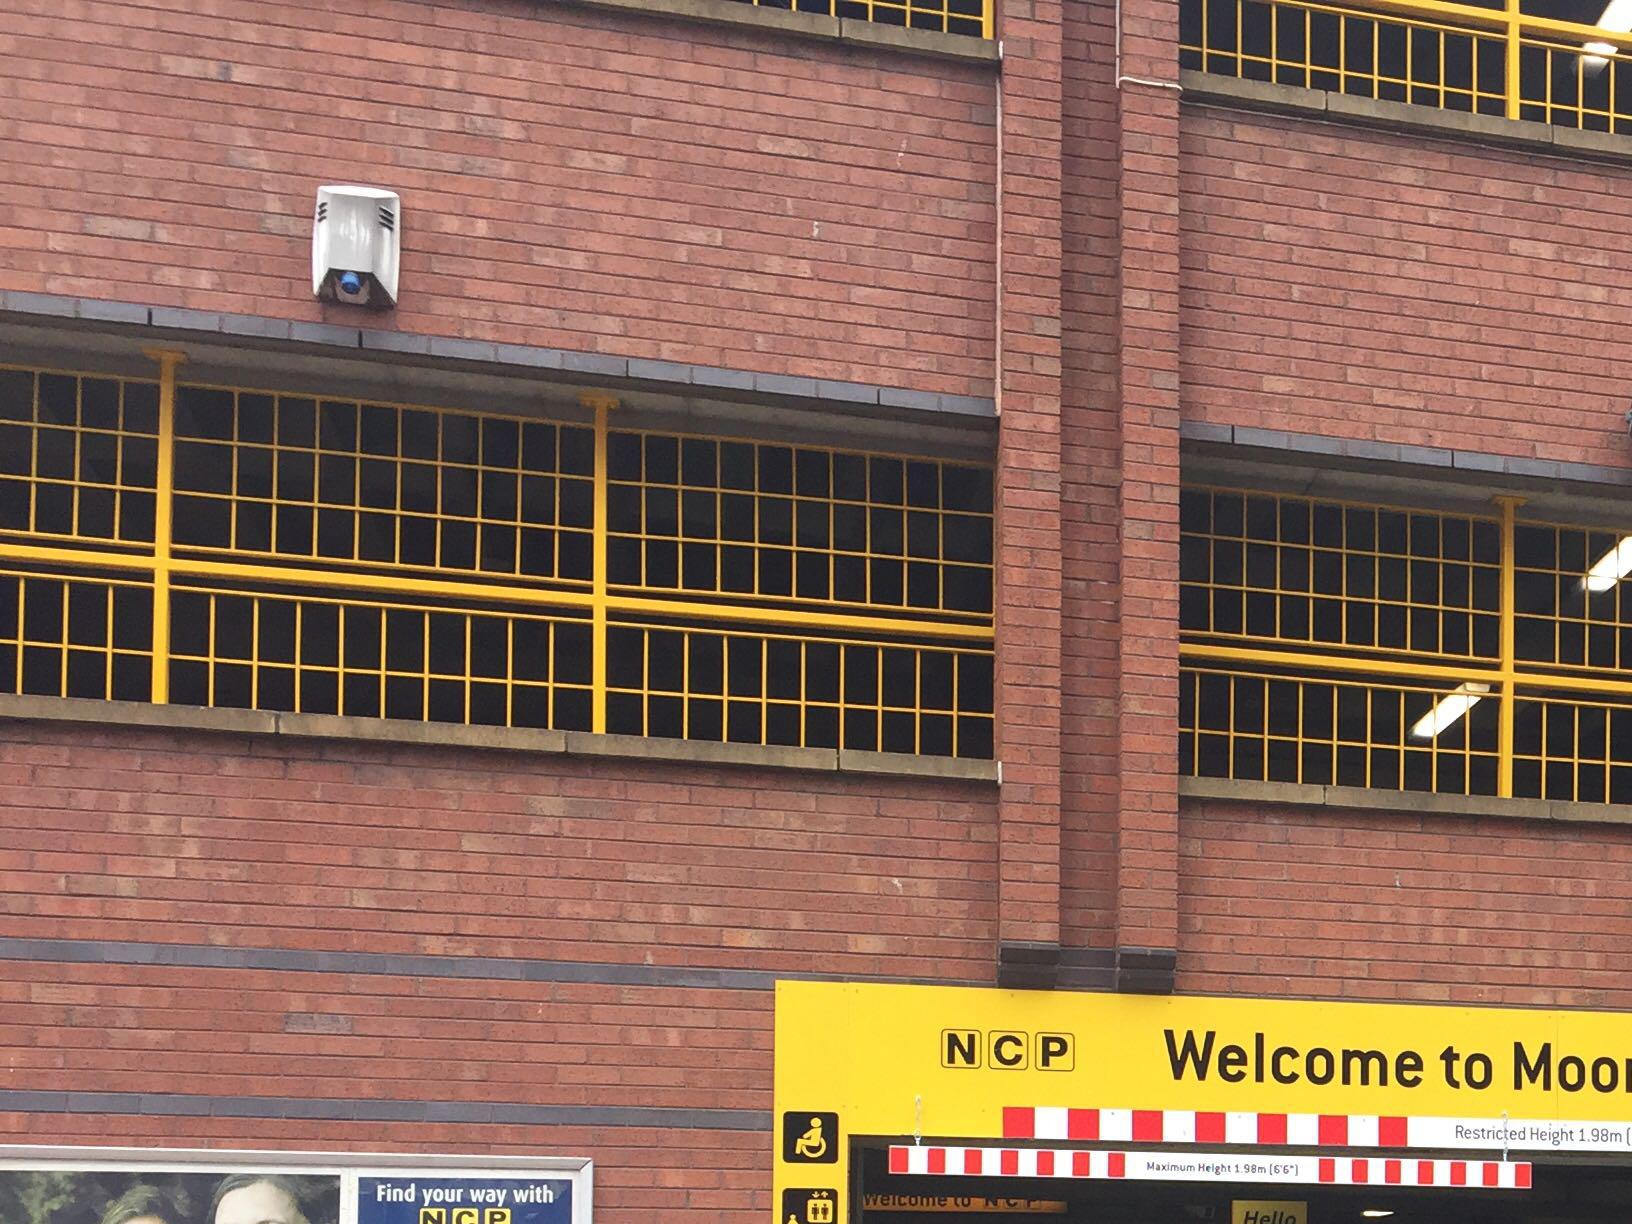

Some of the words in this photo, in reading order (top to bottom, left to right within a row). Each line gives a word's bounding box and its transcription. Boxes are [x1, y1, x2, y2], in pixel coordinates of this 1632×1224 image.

[945, 1032, 1070, 1068] NCP
[1164, 1029, 1424, 1087] Welcome
[1438, 1044, 1493, 1090] to
[1455, 1125, 1525, 1141] Restricted
[1530, 1128, 1574, 1145] Height
[1580, 1128, 1622, 1142] 1.98m
[1147, 1162, 1195, 1171] Maximum
[1198, 1163, 1231, 1175] Height
[1235, 1164, 1266, 1173] 1.98m
[377, 1184, 415, 1202] Find
[422, 1188, 463, 1206] your
[470, 1188, 507, 1207] way
[513, 1185, 553, 1203] with
